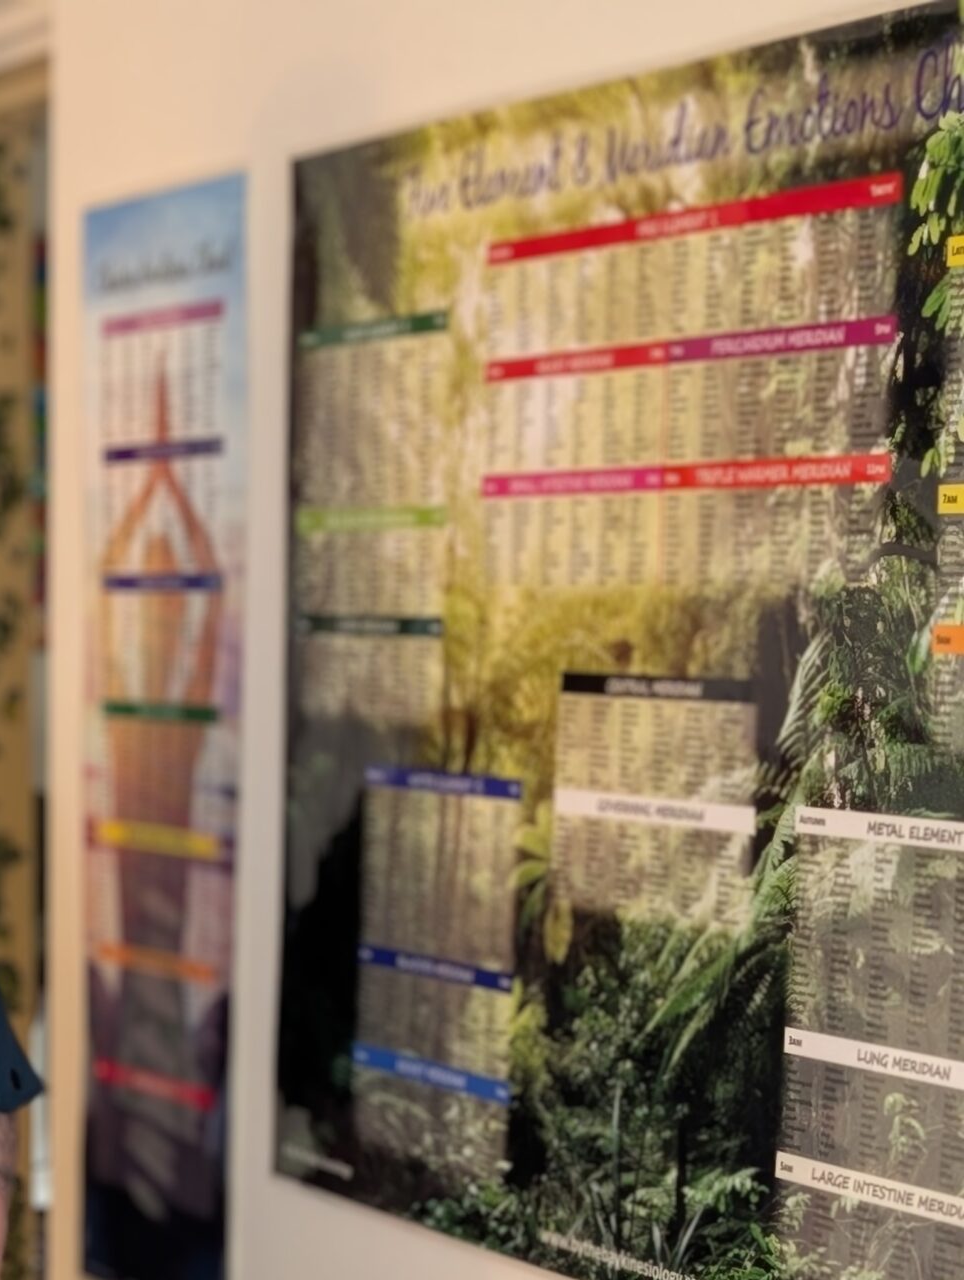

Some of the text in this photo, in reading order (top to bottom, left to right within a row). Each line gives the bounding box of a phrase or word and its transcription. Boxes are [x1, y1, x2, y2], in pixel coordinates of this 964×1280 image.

[745, 72, 899, 154] Emotions
[866, 821, 906, 839] METAL
[908, 826, 964, 844] ELEMENT
[856, 1048, 888, 1068] LUNG
[891, 1056, 952, 1081] MERIDIAN
[811, 1167, 850, 1190] LARGE
[852, 1180, 915, 1207] INTESTINE
